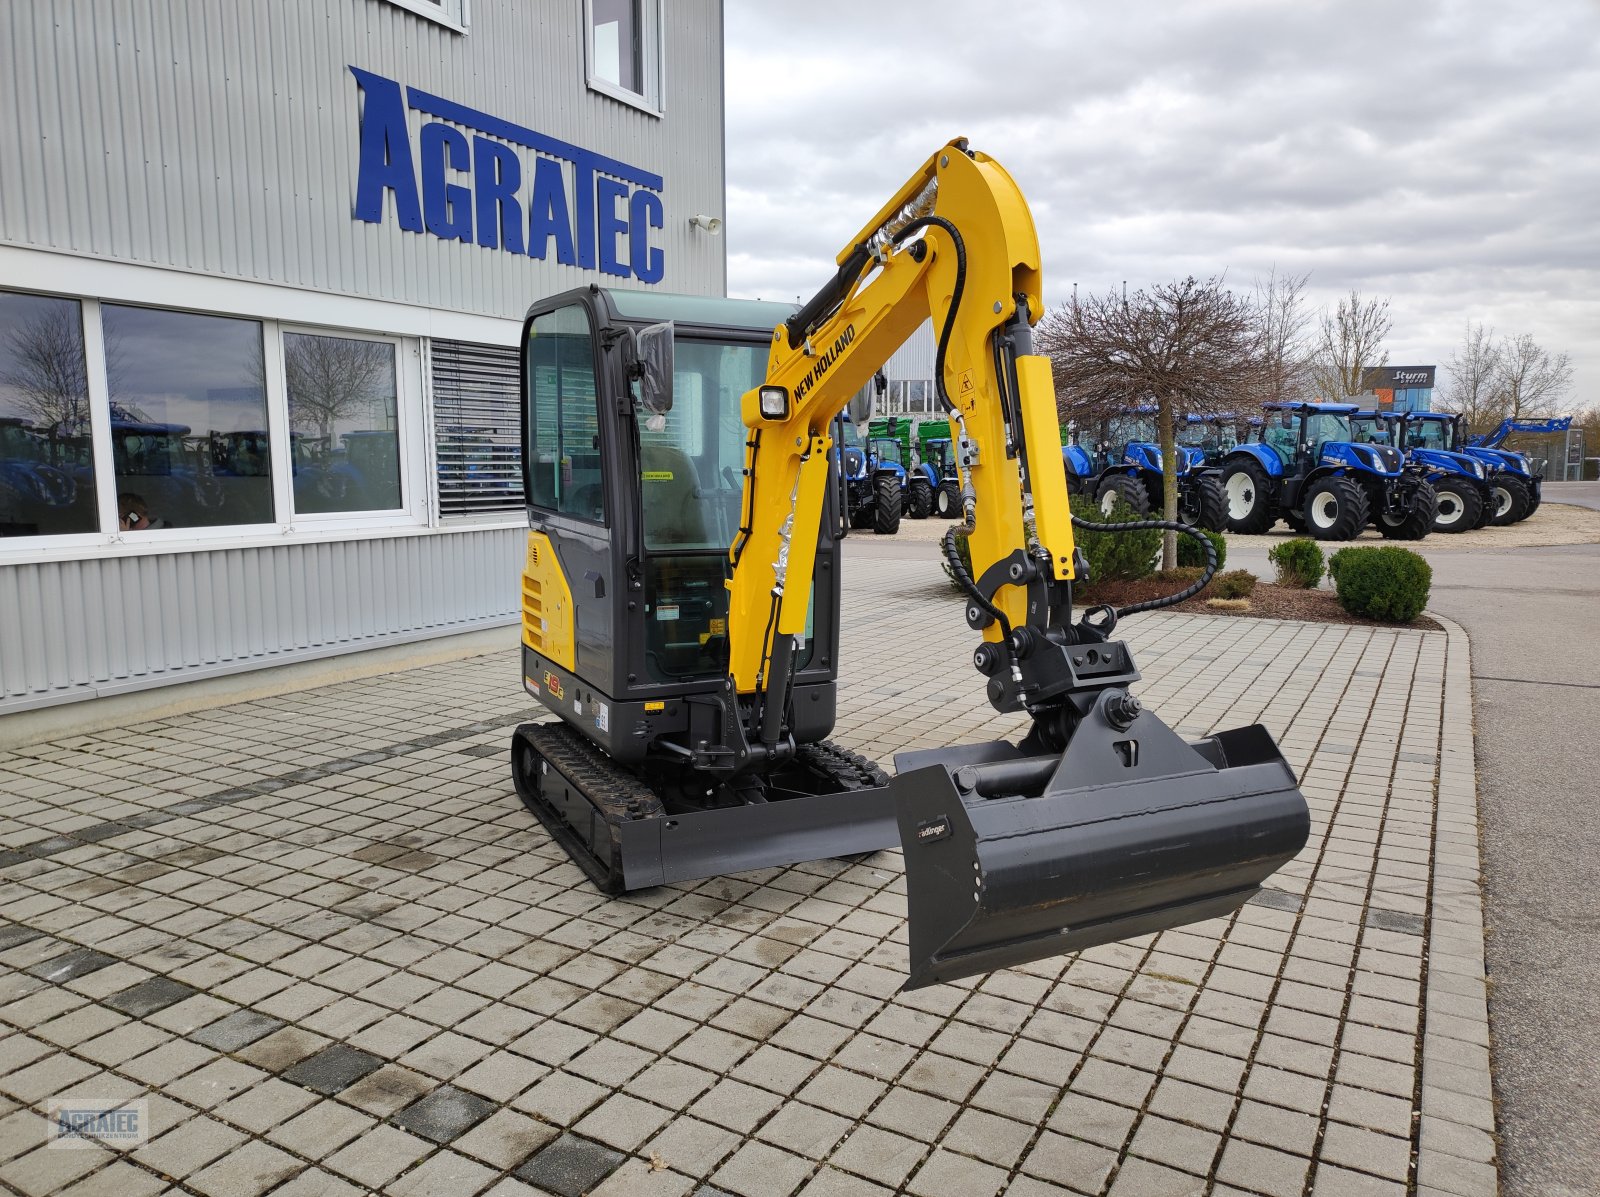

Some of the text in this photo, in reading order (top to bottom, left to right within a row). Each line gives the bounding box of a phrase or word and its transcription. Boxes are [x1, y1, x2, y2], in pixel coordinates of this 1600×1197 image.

[348, 65, 664, 284] AGRATEC
[793, 323, 856, 404] NEW HOLLAND
[1393, 371, 1428, 380] Sturm
